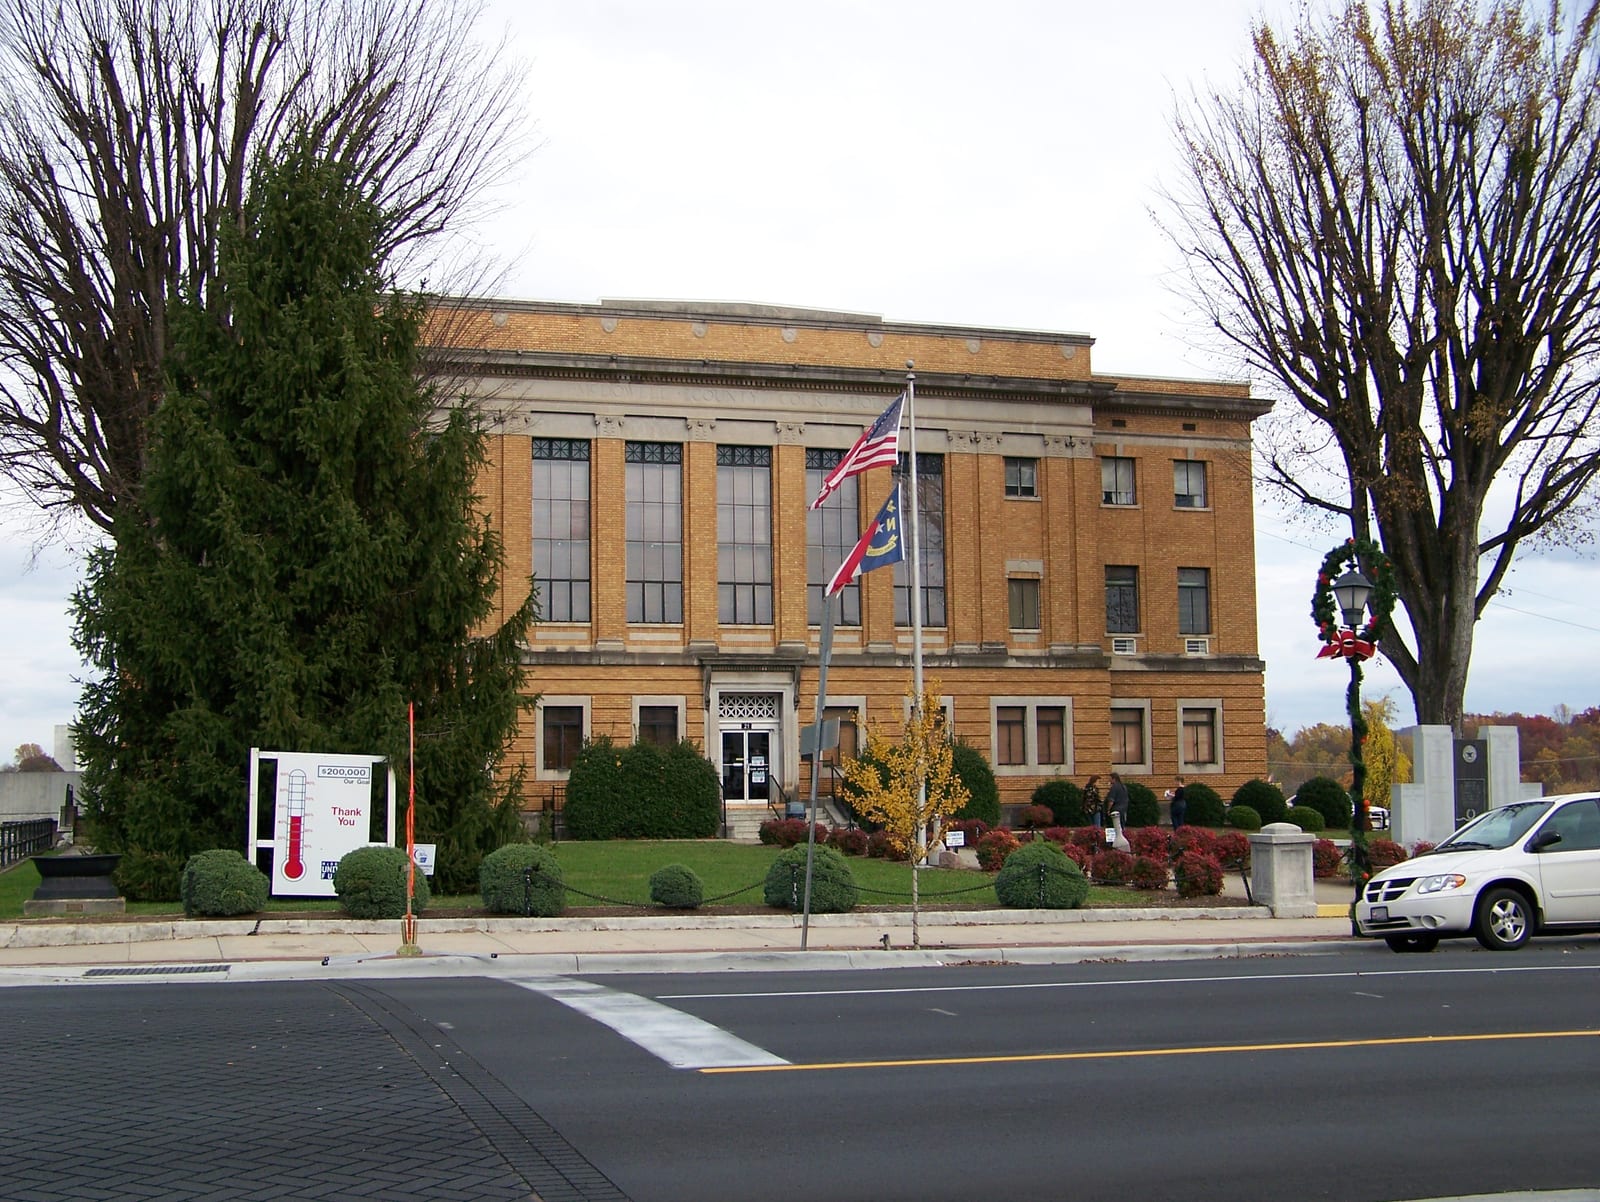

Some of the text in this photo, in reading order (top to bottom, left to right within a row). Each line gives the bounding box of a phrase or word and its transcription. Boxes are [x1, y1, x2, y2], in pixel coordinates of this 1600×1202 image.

[688, 389, 757, 403] COUNTY
[778, 392, 831, 407] COURT
[848, 394, 891, 409] HOUS
[321, 768, 366, 776] $200,000
[331, 806, 362, 816] Thank
[338, 817, 355, 826] You
